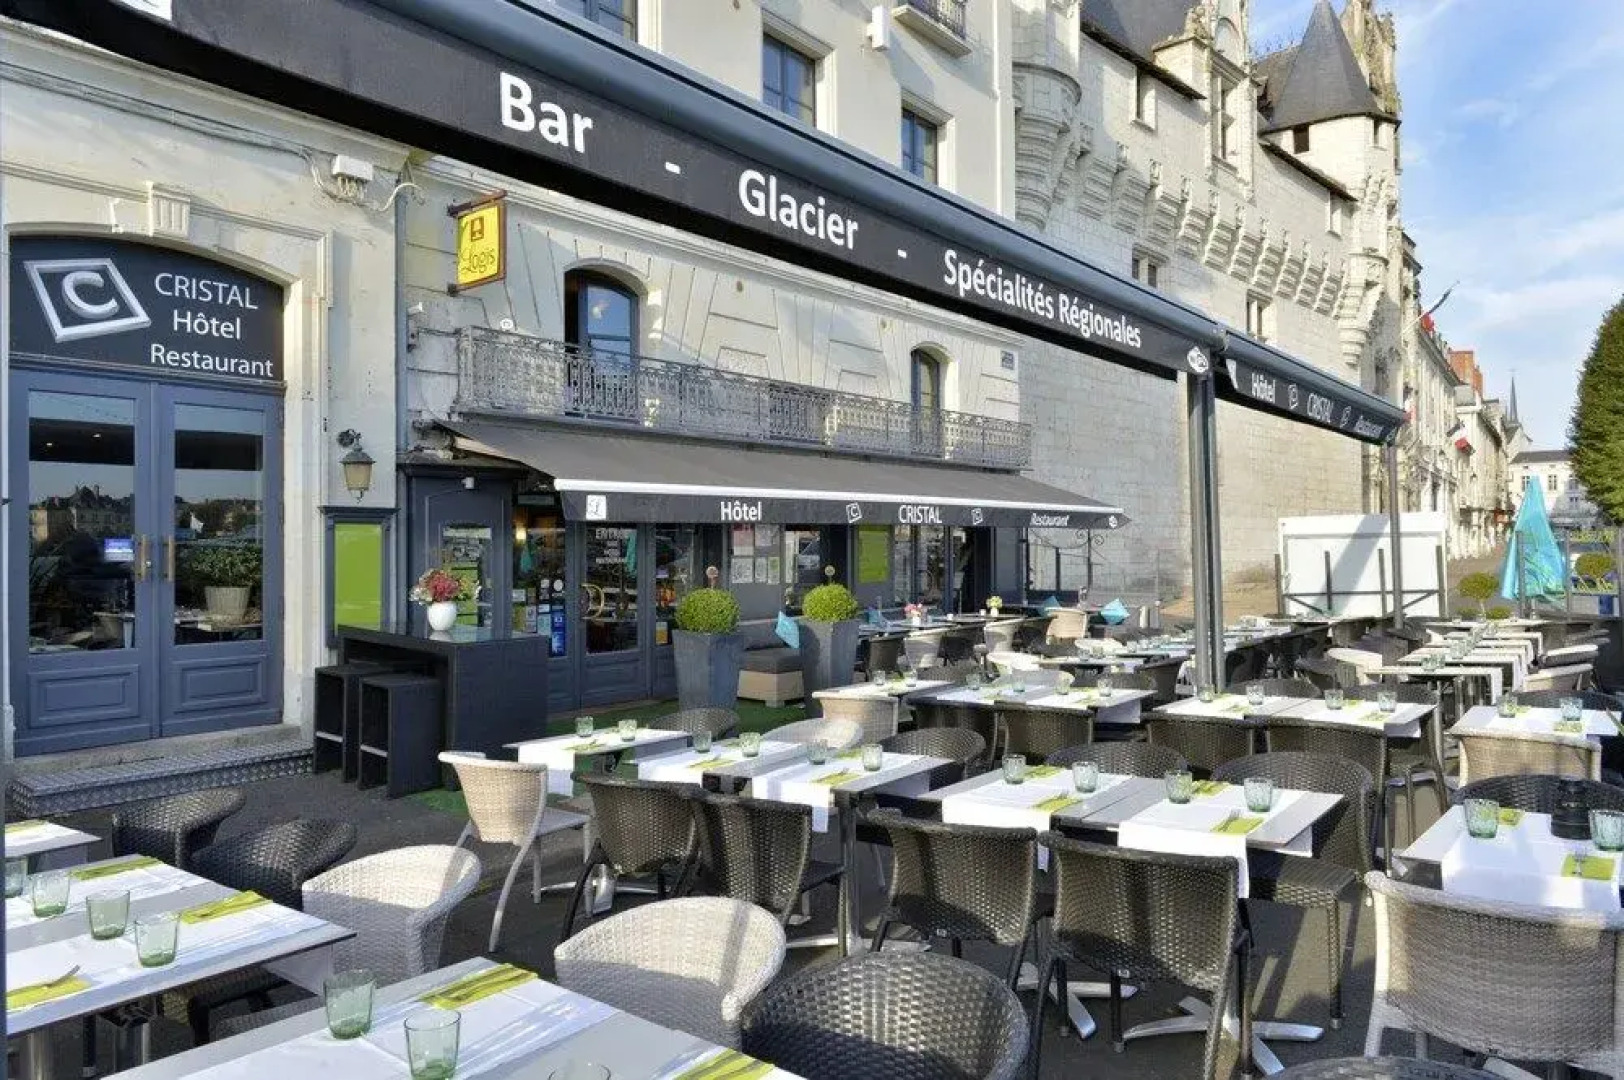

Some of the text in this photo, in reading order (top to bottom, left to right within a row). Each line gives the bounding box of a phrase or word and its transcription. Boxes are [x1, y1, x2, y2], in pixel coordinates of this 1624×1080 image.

[500, 72, 594, 153] Bar
[738, 169, 859, 249] Glacier
[944, 249, 1054, 319] Spécialités
[1058, 293, 1141, 348] Régionales
[155, 272, 259, 310] CRISTAL
[173, 309, 242, 340] Hôtel
[151, 343, 274, 378] Restaurant
[720, 501, 762, 521] Hôtel
[899, 504, 942, 524] CRISTAL
[1030, 512, 1070, 527] Restaurant
